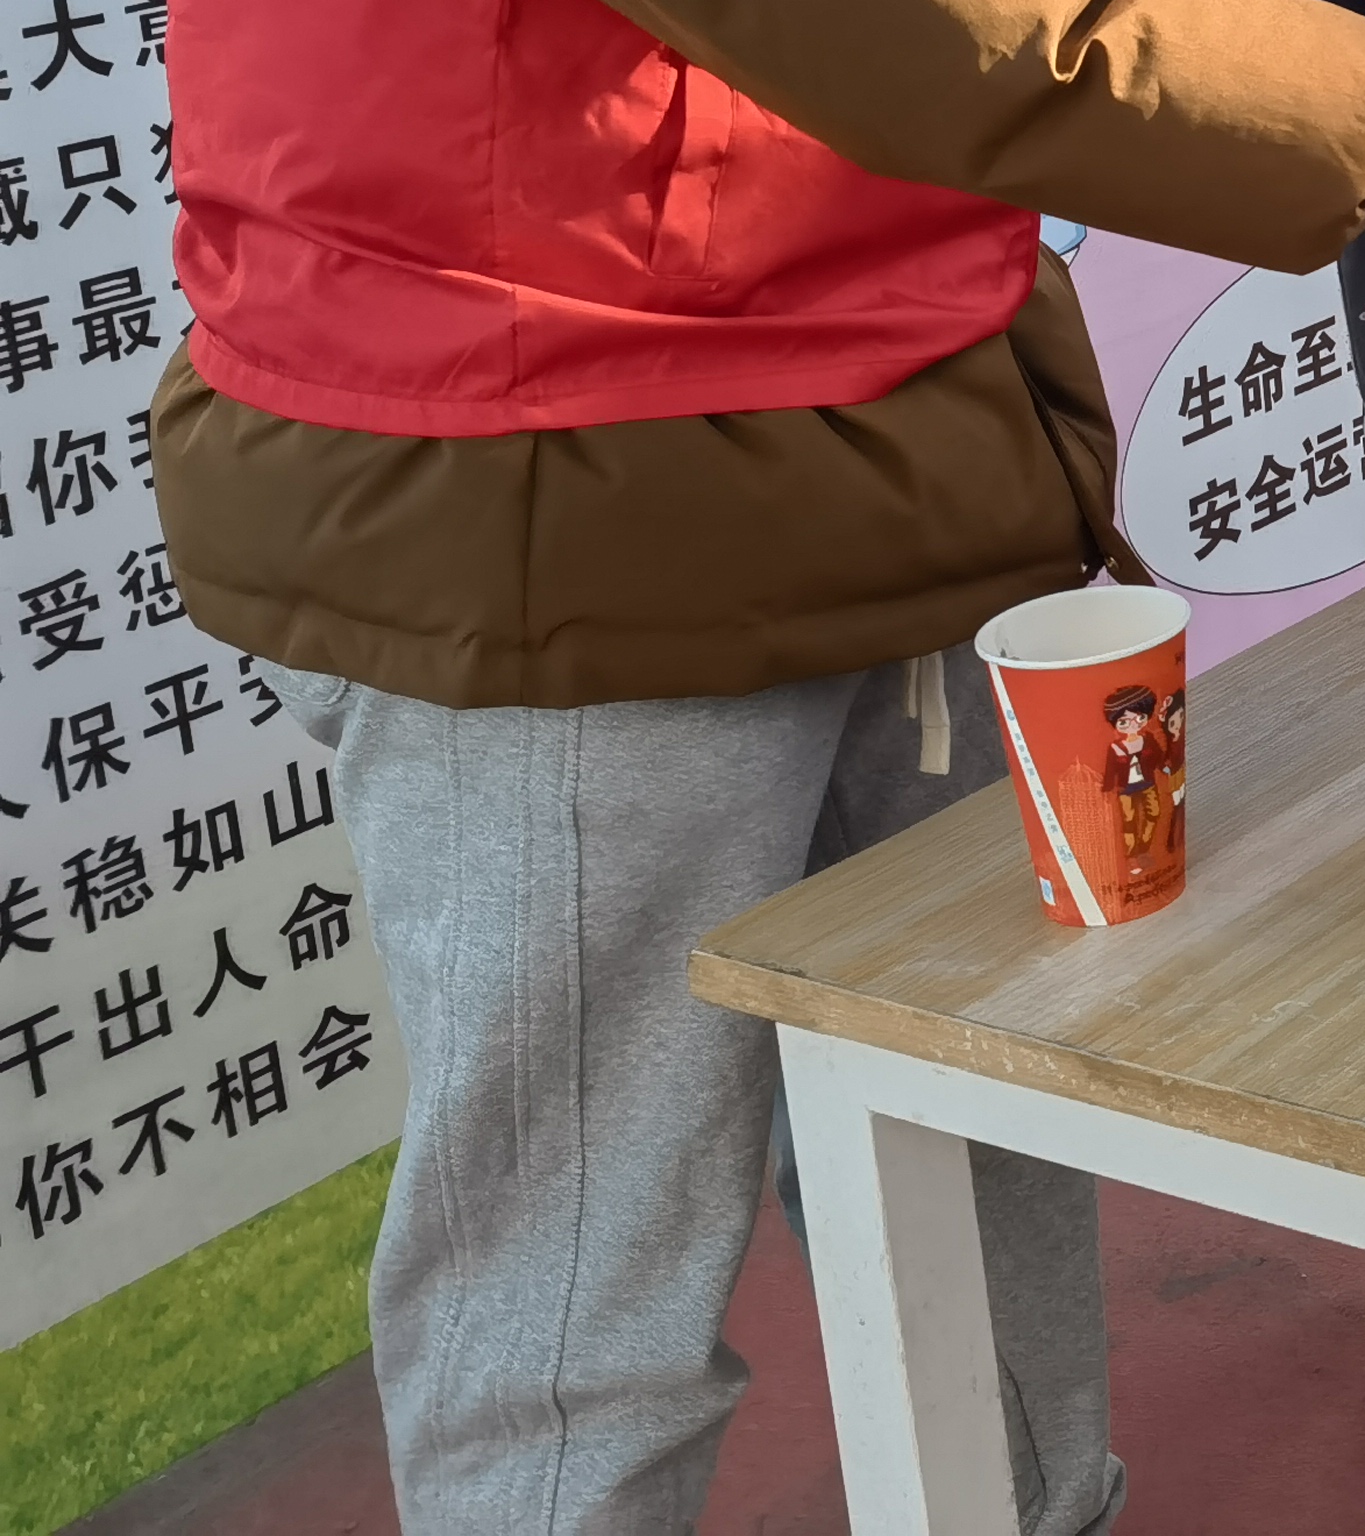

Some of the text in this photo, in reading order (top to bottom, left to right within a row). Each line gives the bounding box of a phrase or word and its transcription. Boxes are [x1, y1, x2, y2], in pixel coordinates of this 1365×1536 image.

[0, 267, 196, 392] 事最
[1178, 315, 1353, 446] 生命至
[0, 882, 353, 1098] 干出人命
[15, 1004, 373, 1240] 你不相会
